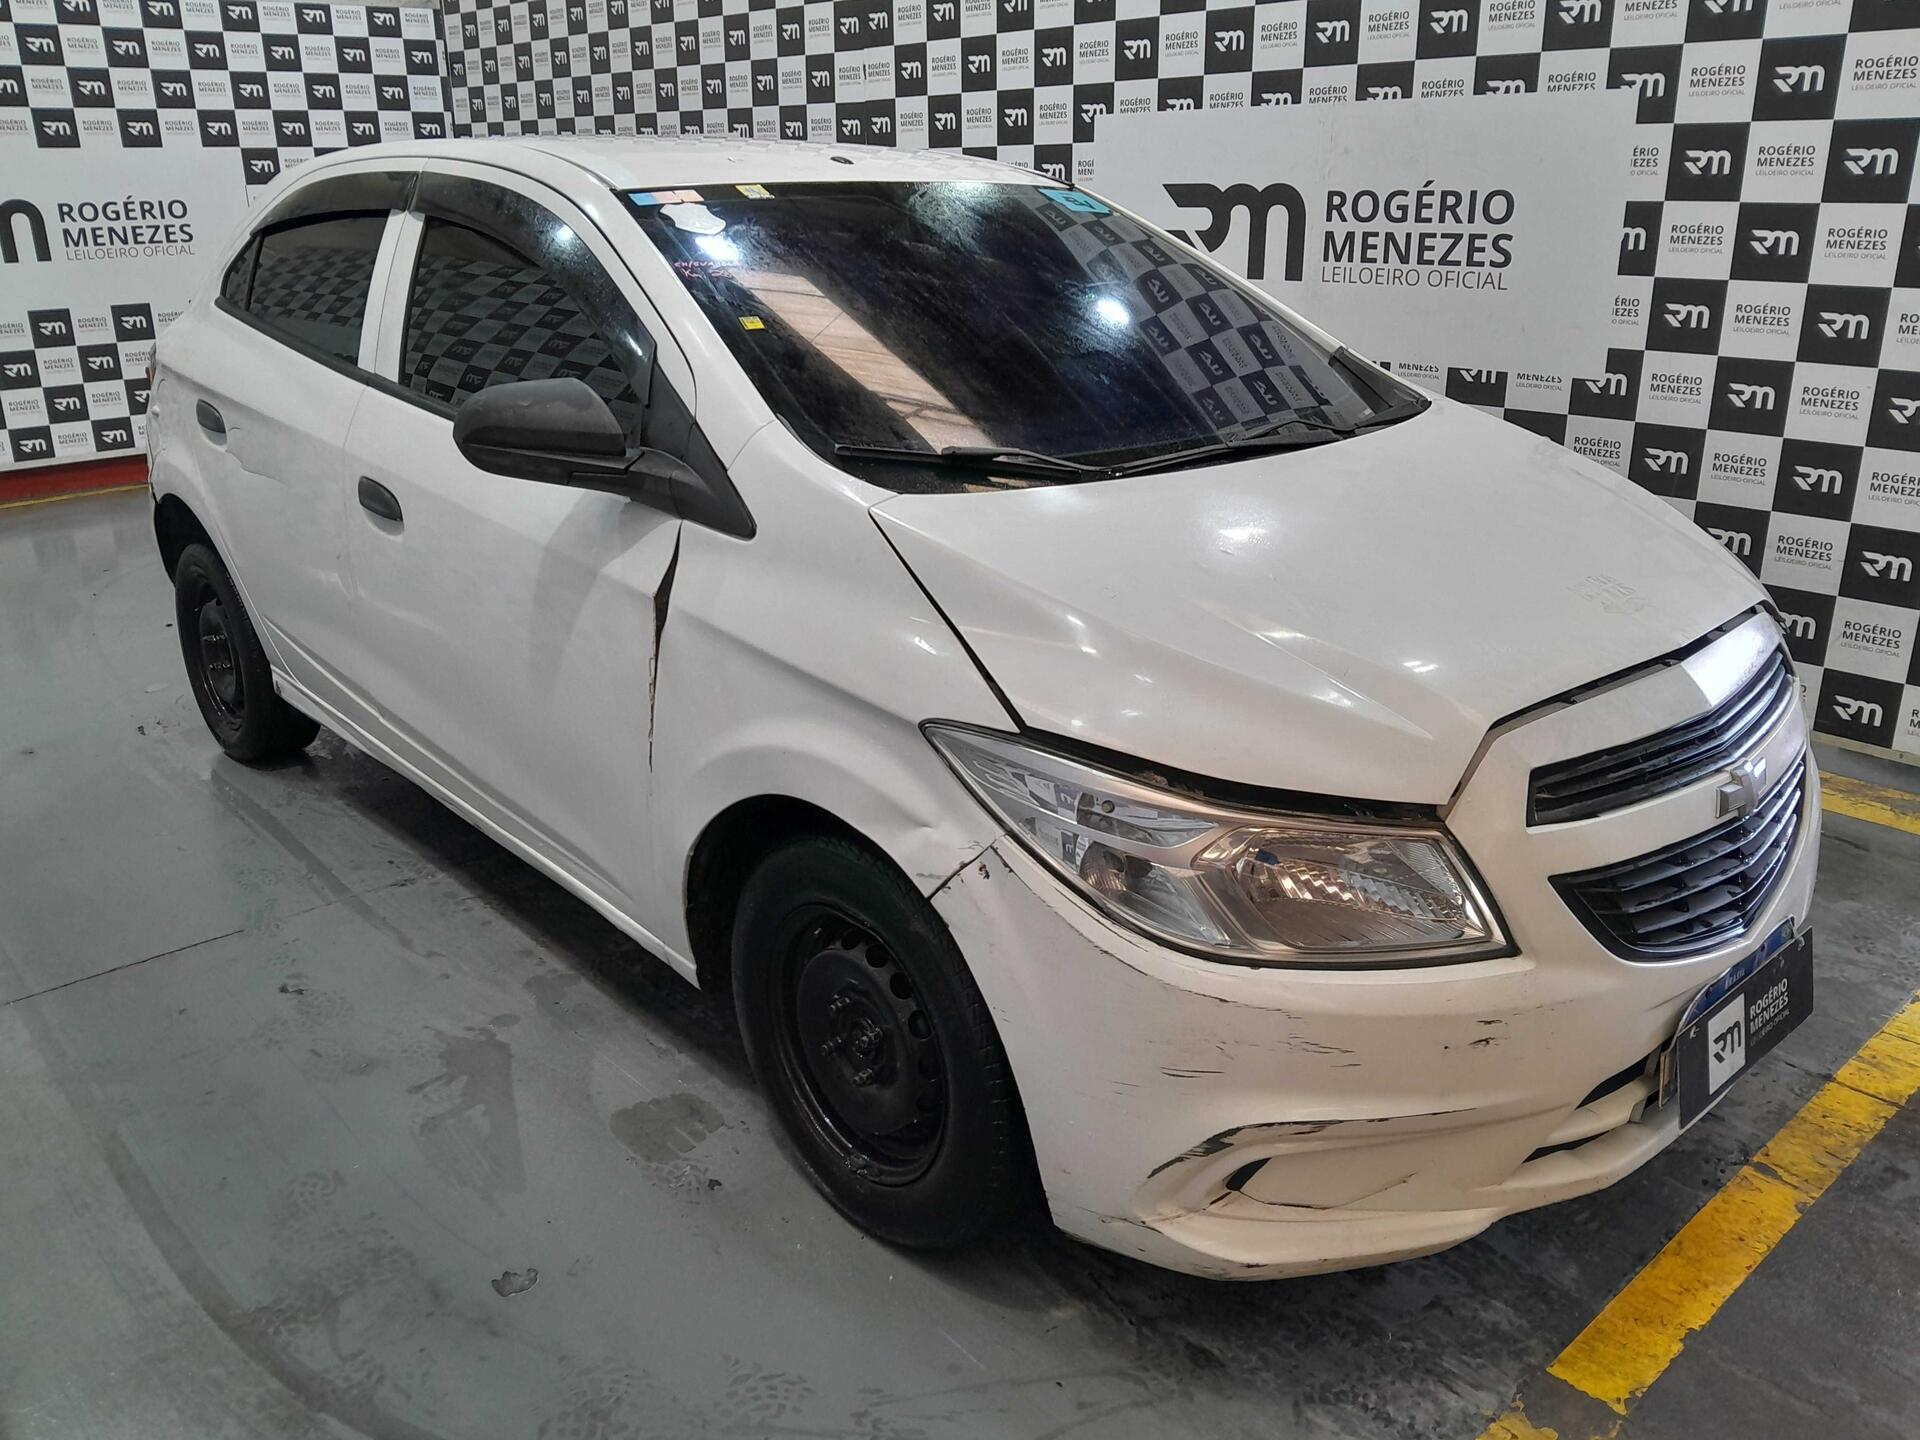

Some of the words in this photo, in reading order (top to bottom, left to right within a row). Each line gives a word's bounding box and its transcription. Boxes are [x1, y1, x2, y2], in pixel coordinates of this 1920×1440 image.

[898, 3, 922, 14] ROGÉRIO
[1489, 0, 1536, 12] ROGÉRIO
[1624, 0, 1678, 12] MENEZES
[898, 12, 922, 21] MENEZES
[1368, 10, 1410, 23] ROGÉRIO
[1488, 10, 1535, 23] MENEZES
[1261, 21, 1298, 32] ROGÉRIO
[1368, 20, 1410, 33] MENEZES
[1165, 30, 1198, 42] ROGÉRIO
[1260, 31, 1298, 42] MENEZES
[1079, 39, 1109, 50] ROGÉRIO
[1165, 40, 1198, 50] MENEZES
[1002, 47, 1029, 57] ROGÉRIO
[1079, 48, 1109, 58] MENEZES
[932, 54, 956, 64] ROGÉRIO
[1002, 56, 1029, 65] MENEZES
[1855, 54, 1919, 69] ROGÉRIO
[838, 65, 861, 74] ROGÉRIO
[868, 61, 890, 70] ROGÉRIO
[932, 63, 956, 72] MENEZES
[1691, 63, 1746, 77] ROGÉRIO
[868, 69, 890, 78] MENEZES
[1548, 70, 1596, 83] ROGÉRIO
[1853, 68, 1917, 81] MENEZES
[1422, 78, 1464, 90] ROGÉRIO
[1690, 76, 1745, 88] MENEZES
[1209, 91, 1244, 102] ROGÉRIO
[1309, 85, 1348, 96] ROGÉRIO
[1039, 102, 1067, 112] ROGÉRIO
[1120, 97, 1151, 107] ROGÉRIO
[900, 111, 924, 120] ROGÉRIO
[966, 107, 992, 116] ROGÉRIO
[1039, 111, 1068, 120] MENEZES
[900, 119, 924, 127] MENEZES
[966, 115, 992, 124] MENEZES
[1632, 145, 1659, 157] ÉRIO
[1758, 144, 1816, 156] ROGÉRIO
[1630, 158, 1658, 168] EZES
[1756, 157, 1815, 167] MENEZES
[1325, 180, 1515, 225] ROGÉRIO
[57, 195, 188, 223] ROGÉRIO
[1671, 223, 1724, 235] ROGÉRIO
[1828, 226, 1888, 239] ROGÉRIO
[62, 223, 194, 248] MENEZES
[1670, 235, 1723, 246] MENEZES
[1323, 230, 1514, 269] MENEZES
[1826, 239, 1886, 251] MENEZES
[66, 247, 139, 261] LEILOEIRO
[143, 244, 195, 257] OFICIAL
[1321, 266, 1420, 286] LEILOEIRO
[1427, 269, 1508, 291] OFICIAL
[1614, 295, 1640, 308] ÉRIO
[1612, 308, 1639, 318] EZES
[1736, 303, 1791, 316] ROGÉRIO
[1734, 314, 1790, 327] MENEZES
[1651, 372, 1702, 386] ROGÉRIO
[1650, 383, 1702, 396] MENEZES
[1802, 386, 1860, 400] ROGÉRIO
[1800, 397, 1859, 411] MENEZES
[1574, 436, 1622, 450] ROGÉRIO
[1572, 446, 1621, 460] MENEZES
[1713, 452, 1767, 467] ROGÉRIO
[1712, 462, 1766, 478] MENEZES
[1872, 472, 1920, 486] ROGÉRI
[1870, 482, 1920, 498] MENEZE
[1778, 534, 1833, 552] ROGÉRIO
[1776, 545, 1832, 562] MENEZES
[1844, 620, 1902, 639] ROGÉRIO
[1842, 630, 1900, 649] MENEZES
[1750, 978, 1788, 1020] ROGÉRIO
[1750, 992, 1789, 1035] MENEZES
